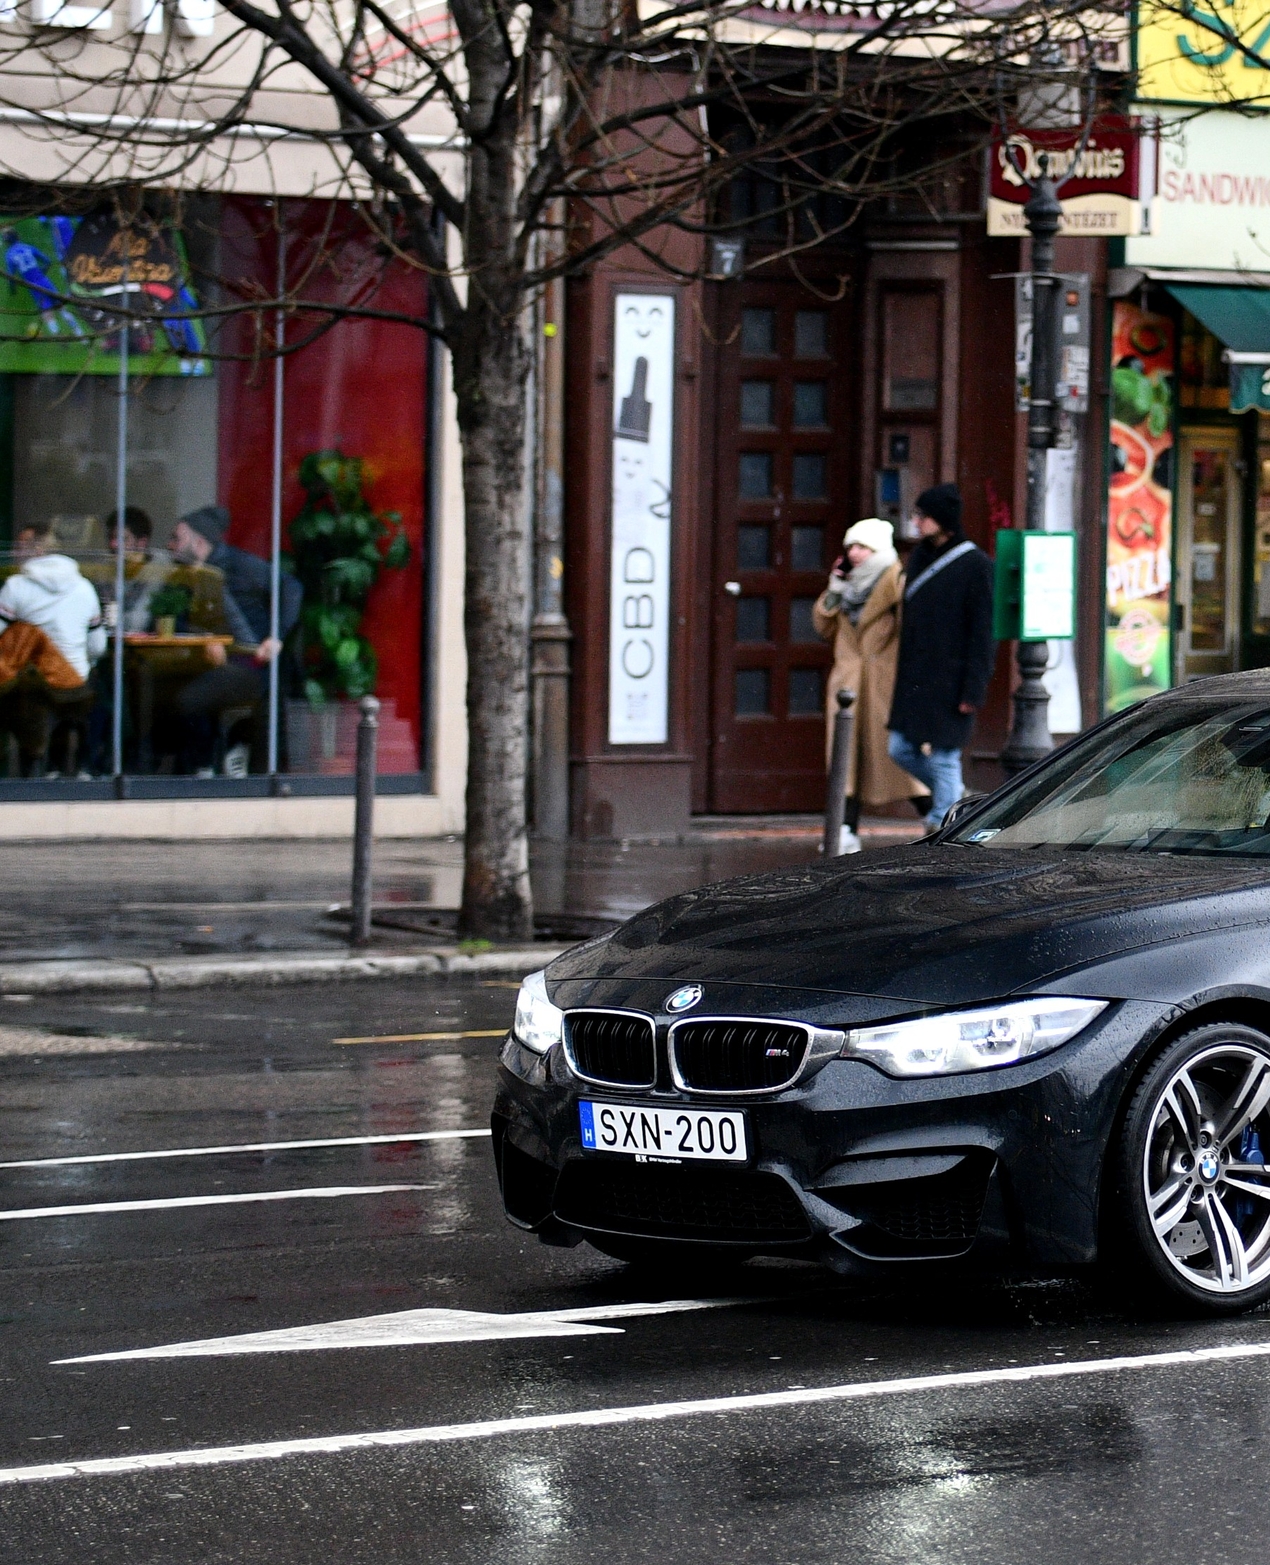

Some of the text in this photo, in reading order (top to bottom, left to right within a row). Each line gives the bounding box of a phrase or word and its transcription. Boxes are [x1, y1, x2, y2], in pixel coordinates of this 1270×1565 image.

[622, 546, 656, 680] CBD
[584, 1108, 737, 1155] H SXN-200
